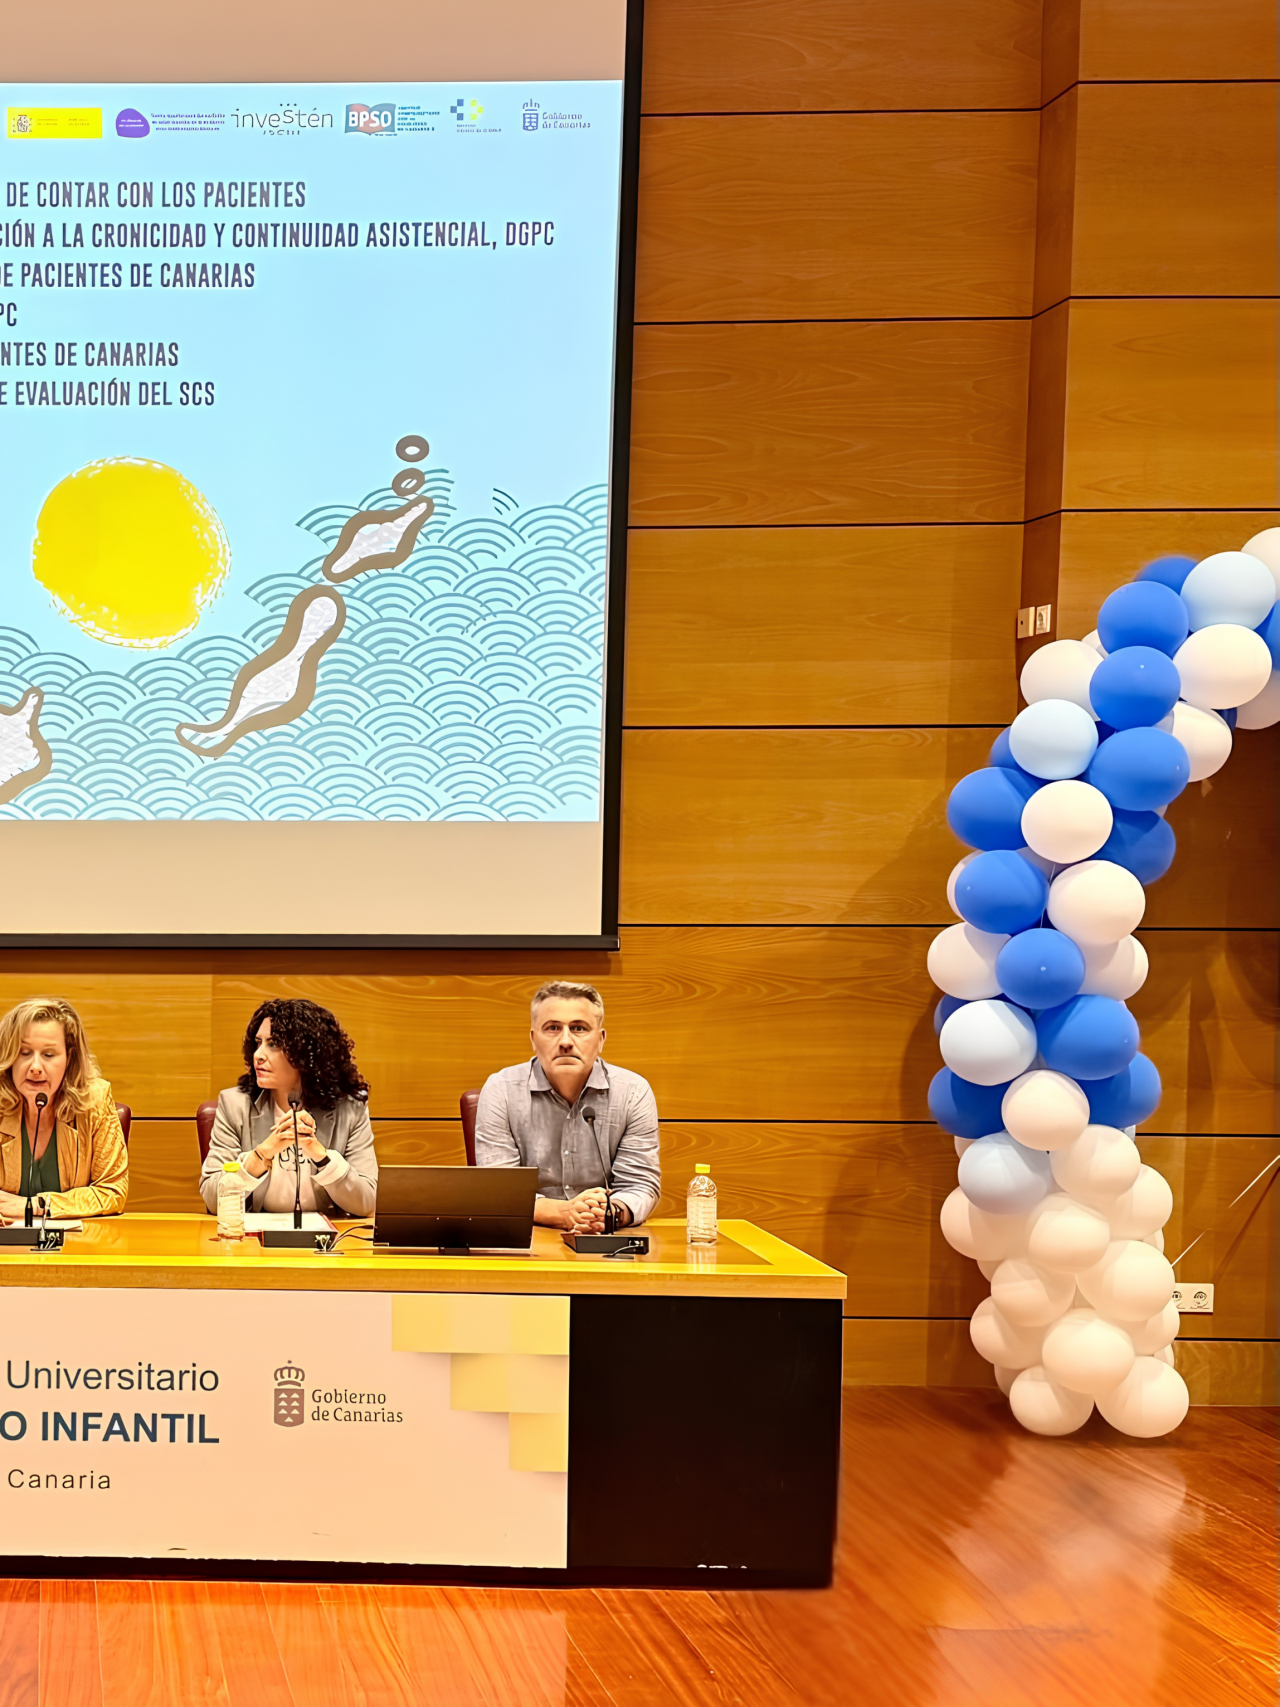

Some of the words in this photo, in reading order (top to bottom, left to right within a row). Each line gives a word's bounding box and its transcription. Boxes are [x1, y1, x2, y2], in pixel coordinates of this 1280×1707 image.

[348, 110, 392, 128] BPSO
[7, 182, 28, 207] DE
[37, 182, 109, 207] CONTAR
[118, 182, 153, 207] CON
[162, 182, 195, 207] LOS
[204, 182, 305, 207] PACIENTES
[43, 223, 54, 247] A
[63, 223, 84, 247] LA
[92, 223, 205, 247] CRONICIDAD
[214, 223, 225, 247] Y
[233, 223, 358, 247] CONTINUIDAD
[366, 222, 496, 250] ASISTENCIAL,
[506, 222, 554, 246] DGPC
[21, 263, 122, 287] PACIENTES
[131, 263, 152, 287] DE
[161, 263, 254, 287] CANARIAS
[55, 343, 77, 366] DE
[85, 342, 178, 366] CANARIAS
[16, 378, 130, 405] EVALUACIÓN
[139, 382, 172, 405] DEL
[180, 382, 214, 406] SCS
[8, 1360, 218, 1391] Universitario
[311, 1388, 387, 1405] Gobierno
[311, 1406, 330, 1422] de
[333, 1407, 404, 1423] Canarias
[42, 1412, 219, 1443] INFANTIL
[8, 1469, 110, 1489] Canaria
